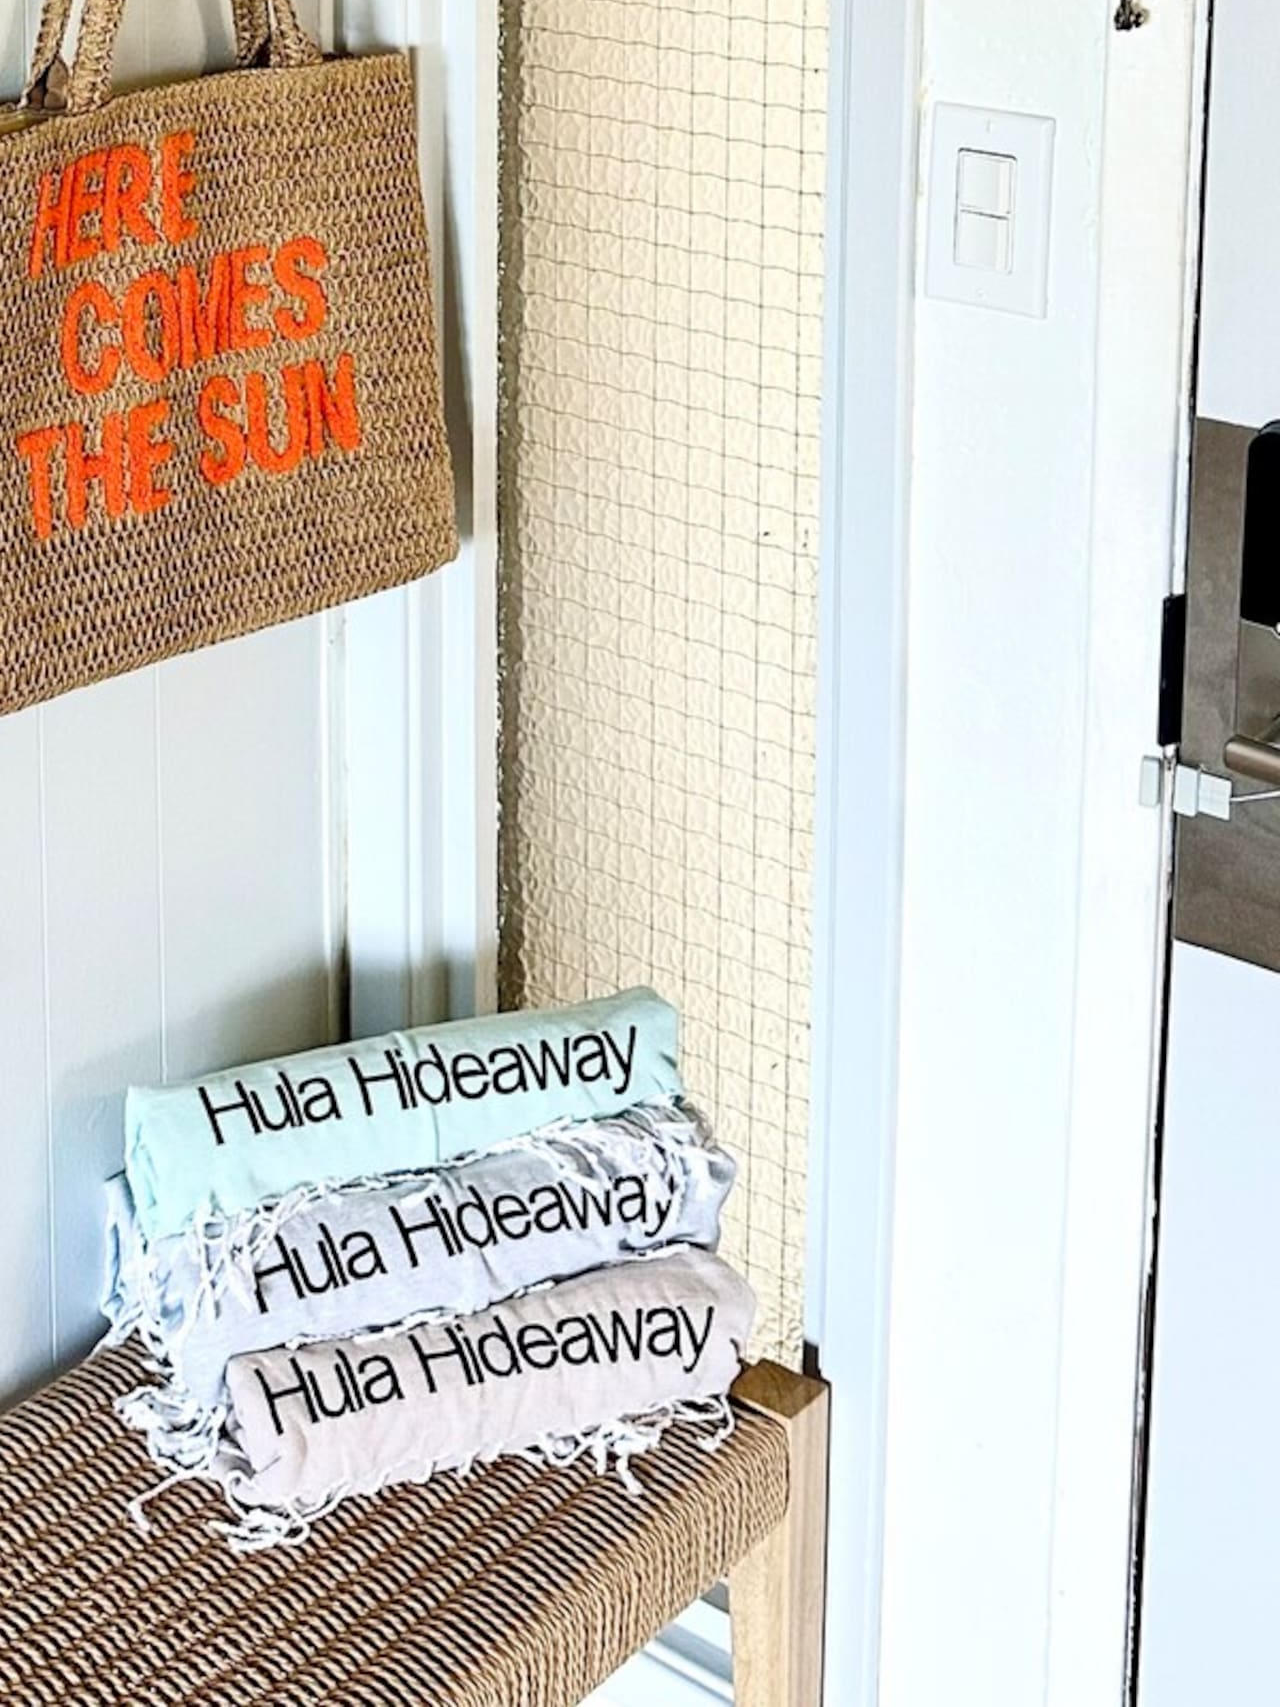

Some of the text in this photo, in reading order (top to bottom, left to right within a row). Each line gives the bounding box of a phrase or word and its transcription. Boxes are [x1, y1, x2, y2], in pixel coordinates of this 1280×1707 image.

[30, 129, 198, 280] HERE
[61, 236, 328, 395] COMES
[19, 352, 361, 541] THE SUN
[199, 1025, 637, 1145] Hula Hideaway
[254, 1174, 676, 1314] Hula Hideaway
[254, 1305, 715, 1434] Hula Hideaway
